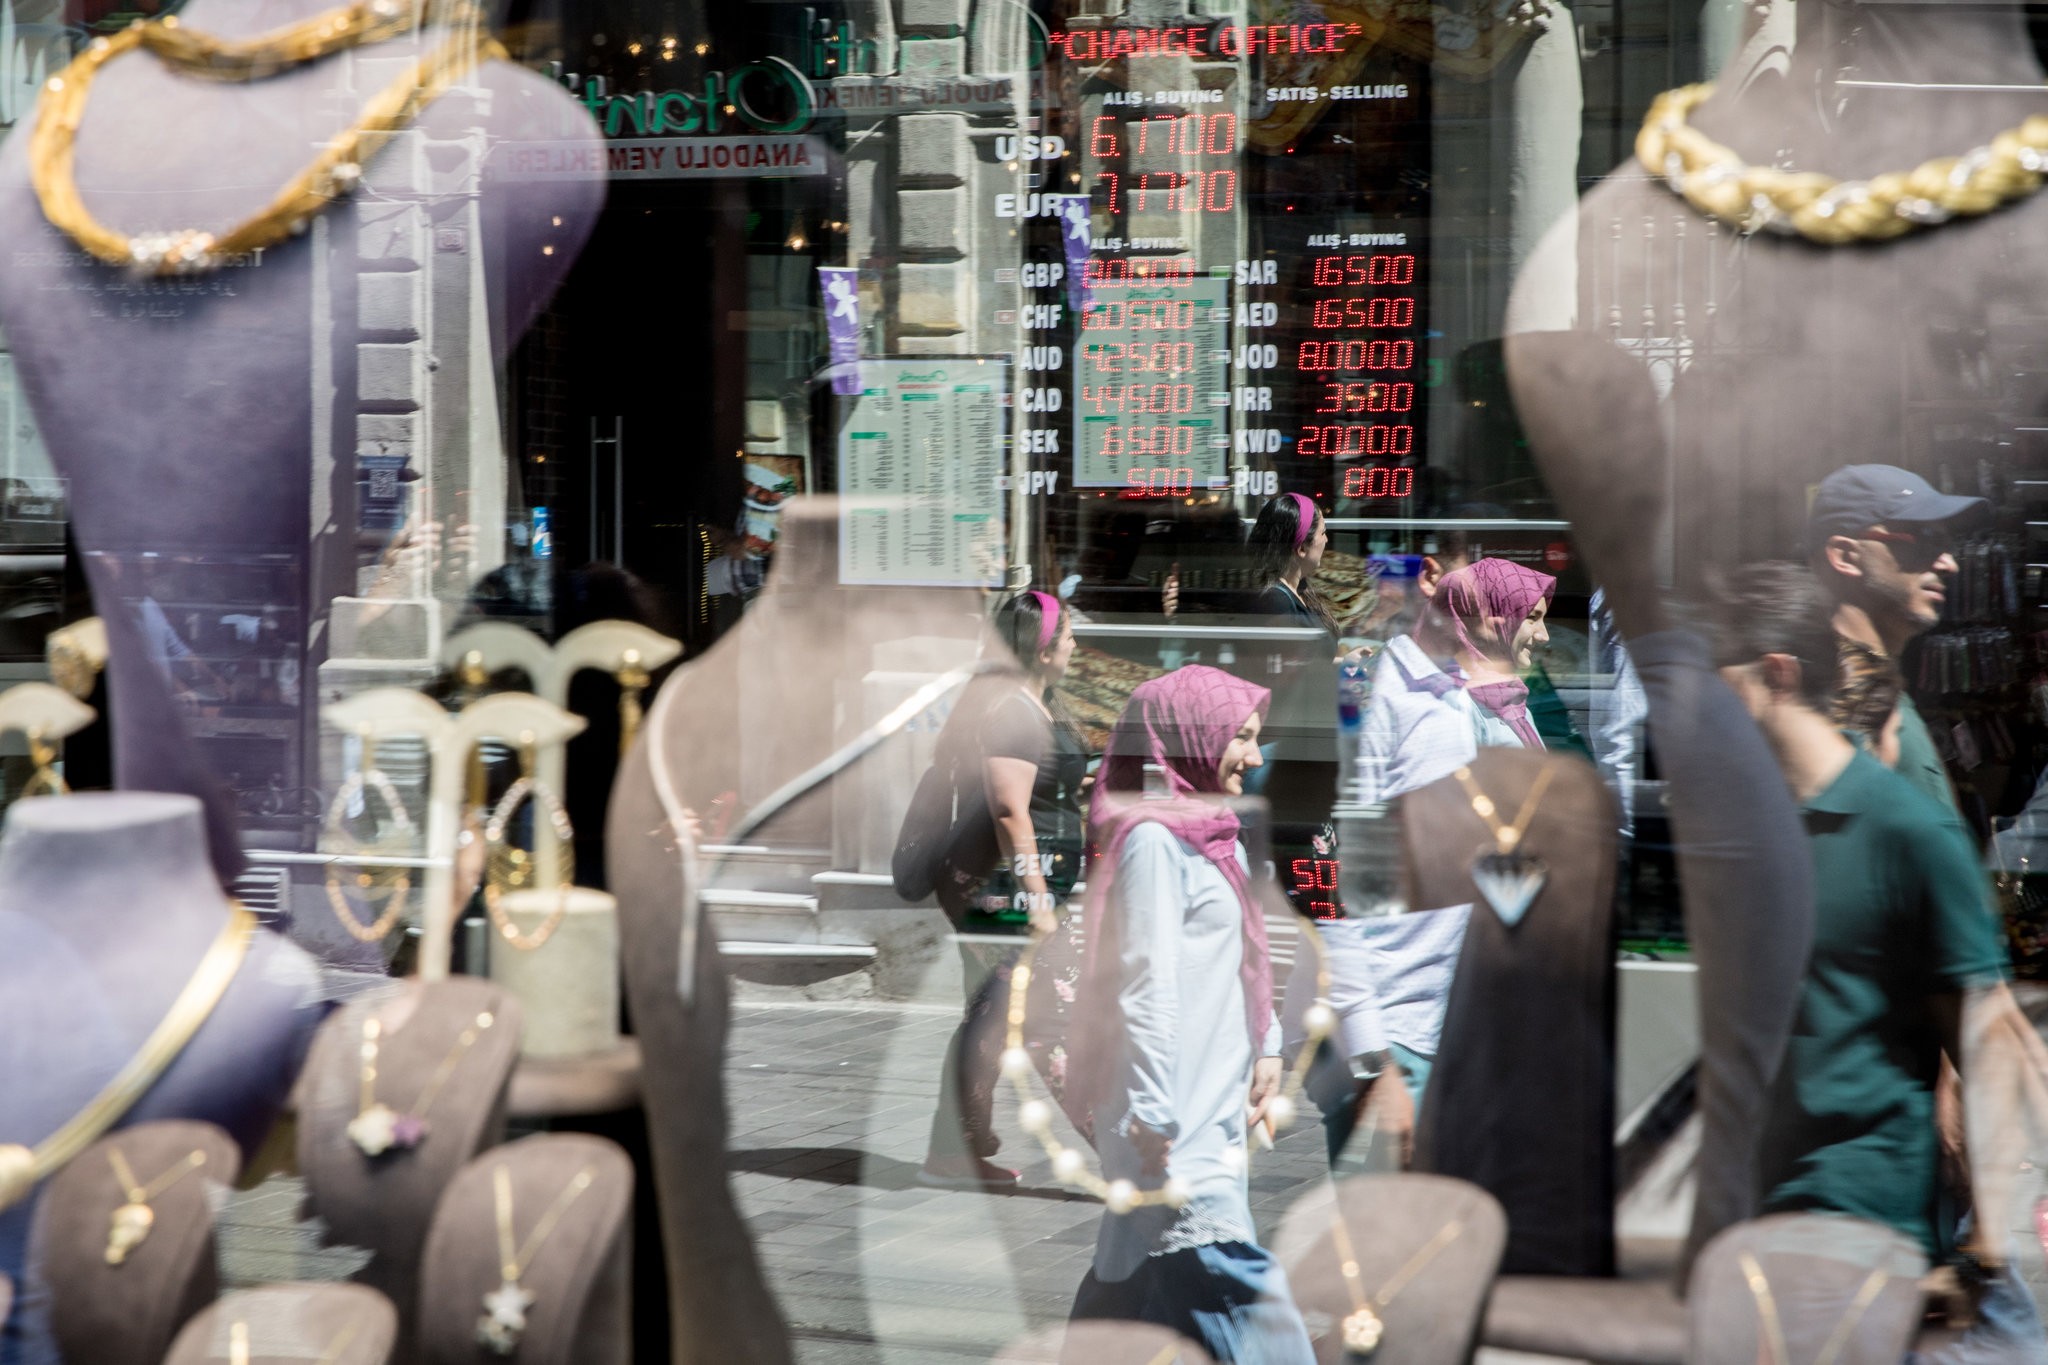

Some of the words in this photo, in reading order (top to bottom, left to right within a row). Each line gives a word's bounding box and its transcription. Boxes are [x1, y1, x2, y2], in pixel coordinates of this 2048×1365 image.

[1154, 89, 1224, 105] BUYING
[1329, 84, 1409, 100] SELLING
[994, 135, 1065, 161] USD
[994, 193, 1065, 218] EUR
[1349, 232, 1407, 246] BUYING
[1021, 262, 1064, 287] GBP
[1235, 260, 1278, 285] SAR
[1020, 304, 1063, 330] CHF
[1234, 302, 1279, 327] AED
[1020, 346, 1063, 371] AUD
[1234, 343, 1279, 369] JOD
[1020, 387, 1062, 413] CAD
[1234, 386, 1273, 411] IRR
[1019, 429, 1060, 454] SEK
[1234, 429, 1282, 454] KWD
[1018, 470, 1058, 496] JPY
[1234, 470, 1279, 496] RUB
